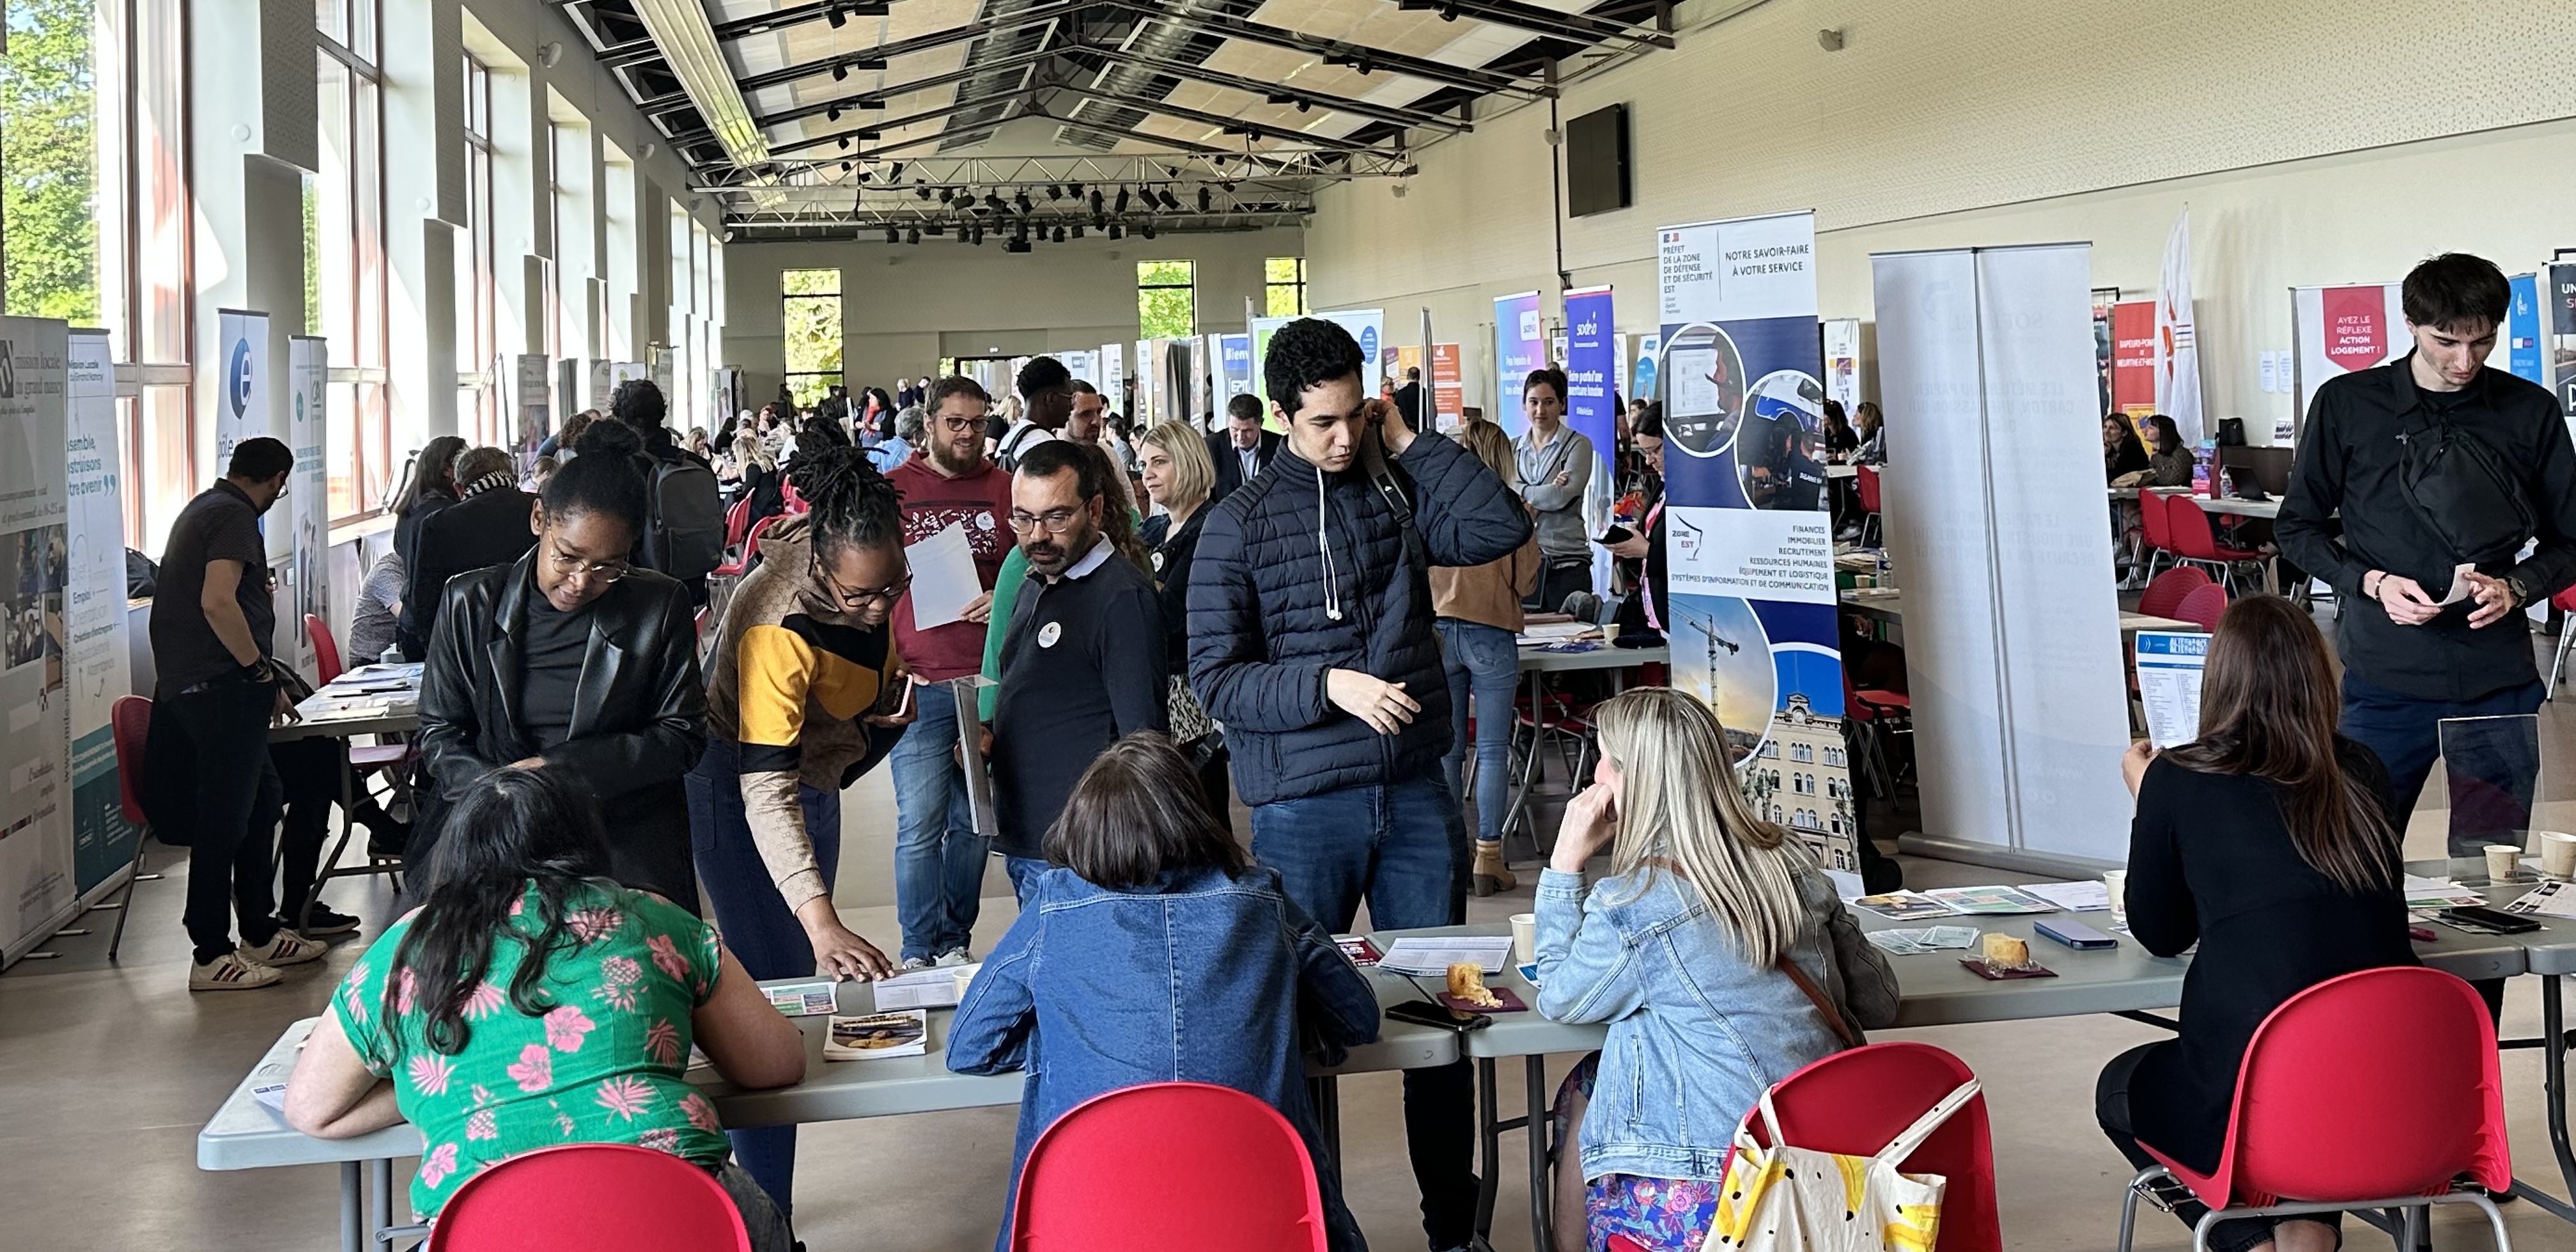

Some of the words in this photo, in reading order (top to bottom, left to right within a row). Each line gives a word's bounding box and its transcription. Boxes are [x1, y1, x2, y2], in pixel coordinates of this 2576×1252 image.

[1663, 245, 1685, 254] PRÉFET
[1725, 250, 1752, 262] NOTRE
[1753, 244, 1810, 259] SAVOIR-FAIRE
[1673, 255, 1681, 263] LA
[1682, 253, 1701, 263] ZONE
[1663, 266, 1672, 274] DE
[1674, 263, 1701, 274] DÉFENSE
[1732, 265, 1739, 276] À
[1740, 265, 1766, 276] VOTRE
[1768, 262, 1803, 273] SERVICE
[1664, 276, 1672, 284] ET
[1673, 275, 1681, 284] DE
[1682, 270, 1713, 283] SÉCURITÉ
[1664, 285, 1675, 293] EST
[2338, 316, 2359, 324] AYEZ
[2360, 315, 2370, 324] LE
[2336, 325, 2372, 334] RÉFLEXE
[2331, 346, 2376, 355] LOGEMENT
[41, 352, 60, 370] locale
[67, 434, 96, 452] semble,
[1792, 525, 1826, 535] FINANCES
[1787, 536, 1826, 545] IMMOBILIER
[1778, 547, 1827, 557] RECRUTEMENT
[1750, 557, 1791, 567] RESSOURCES
[1792, 559, 1827, 569] HUMAINES
[1739, 566, 1777, 577] ÉQUIPEMENT
[1788, 570, 1829, 580] LOGISTIQUE
[1671, 572, 1702, 583] SYSTÈMES
[1702, 575, 1750, 586] D'INFORMATION
[1758, 580, 1767, 588] DE
[1768, 581, 1829, 591] COMMUNICATION
